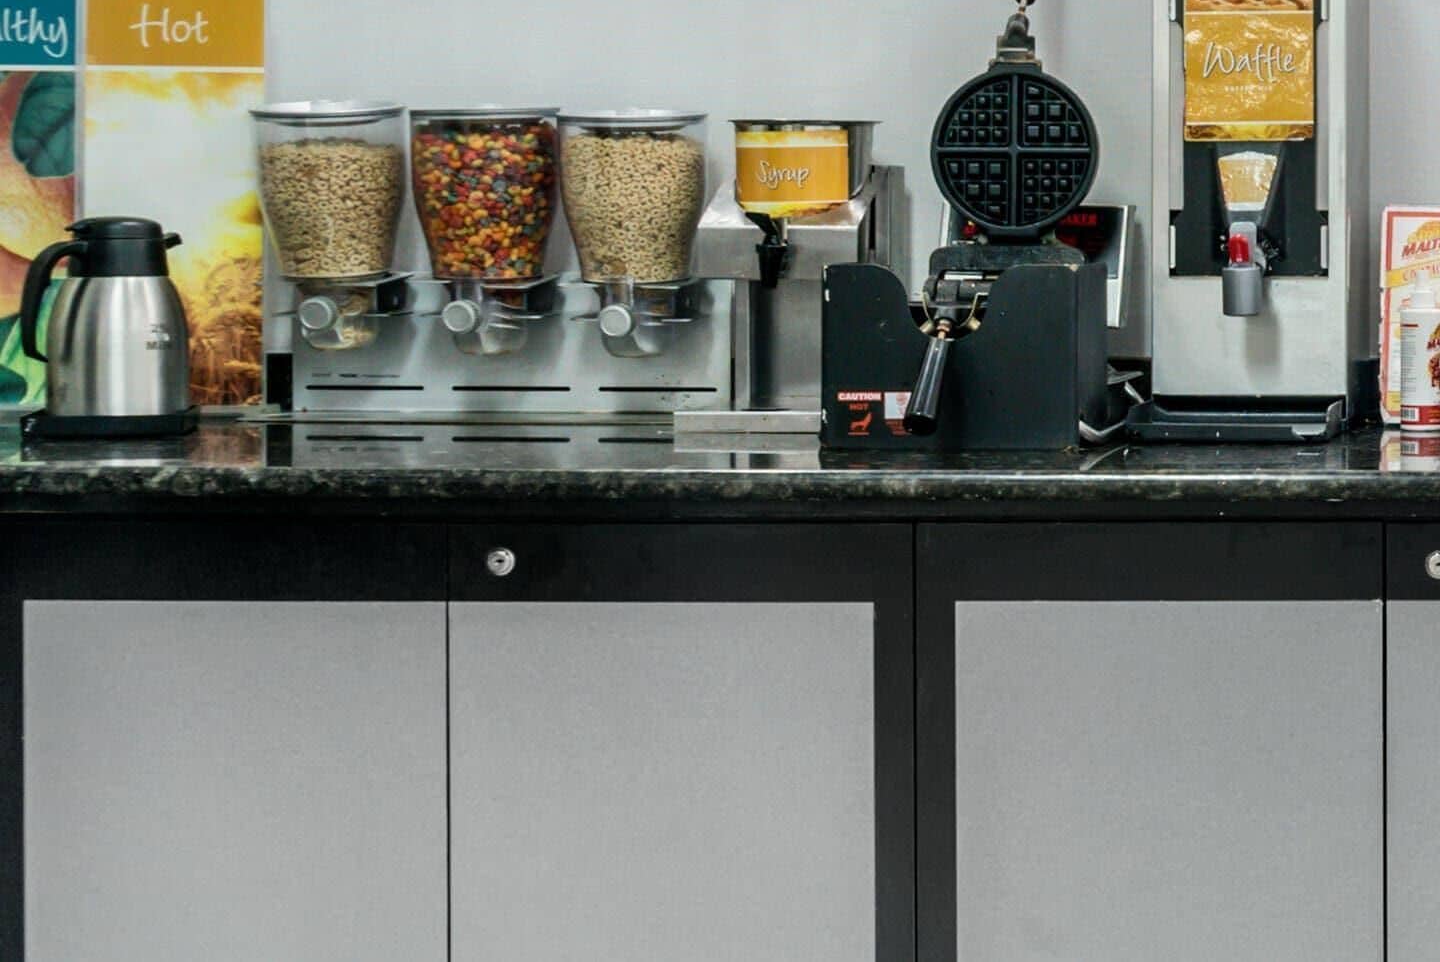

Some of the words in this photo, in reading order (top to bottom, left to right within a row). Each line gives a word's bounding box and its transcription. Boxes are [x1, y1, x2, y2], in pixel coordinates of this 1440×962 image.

[0, 6, 68, 58] lthy
[129, 2, 209, 48] Hot
[1202, 41, 1296, 83] Waffle
[755, 159, 809, 190] Syrup
[837, 391, 882, 402] CAUTION
